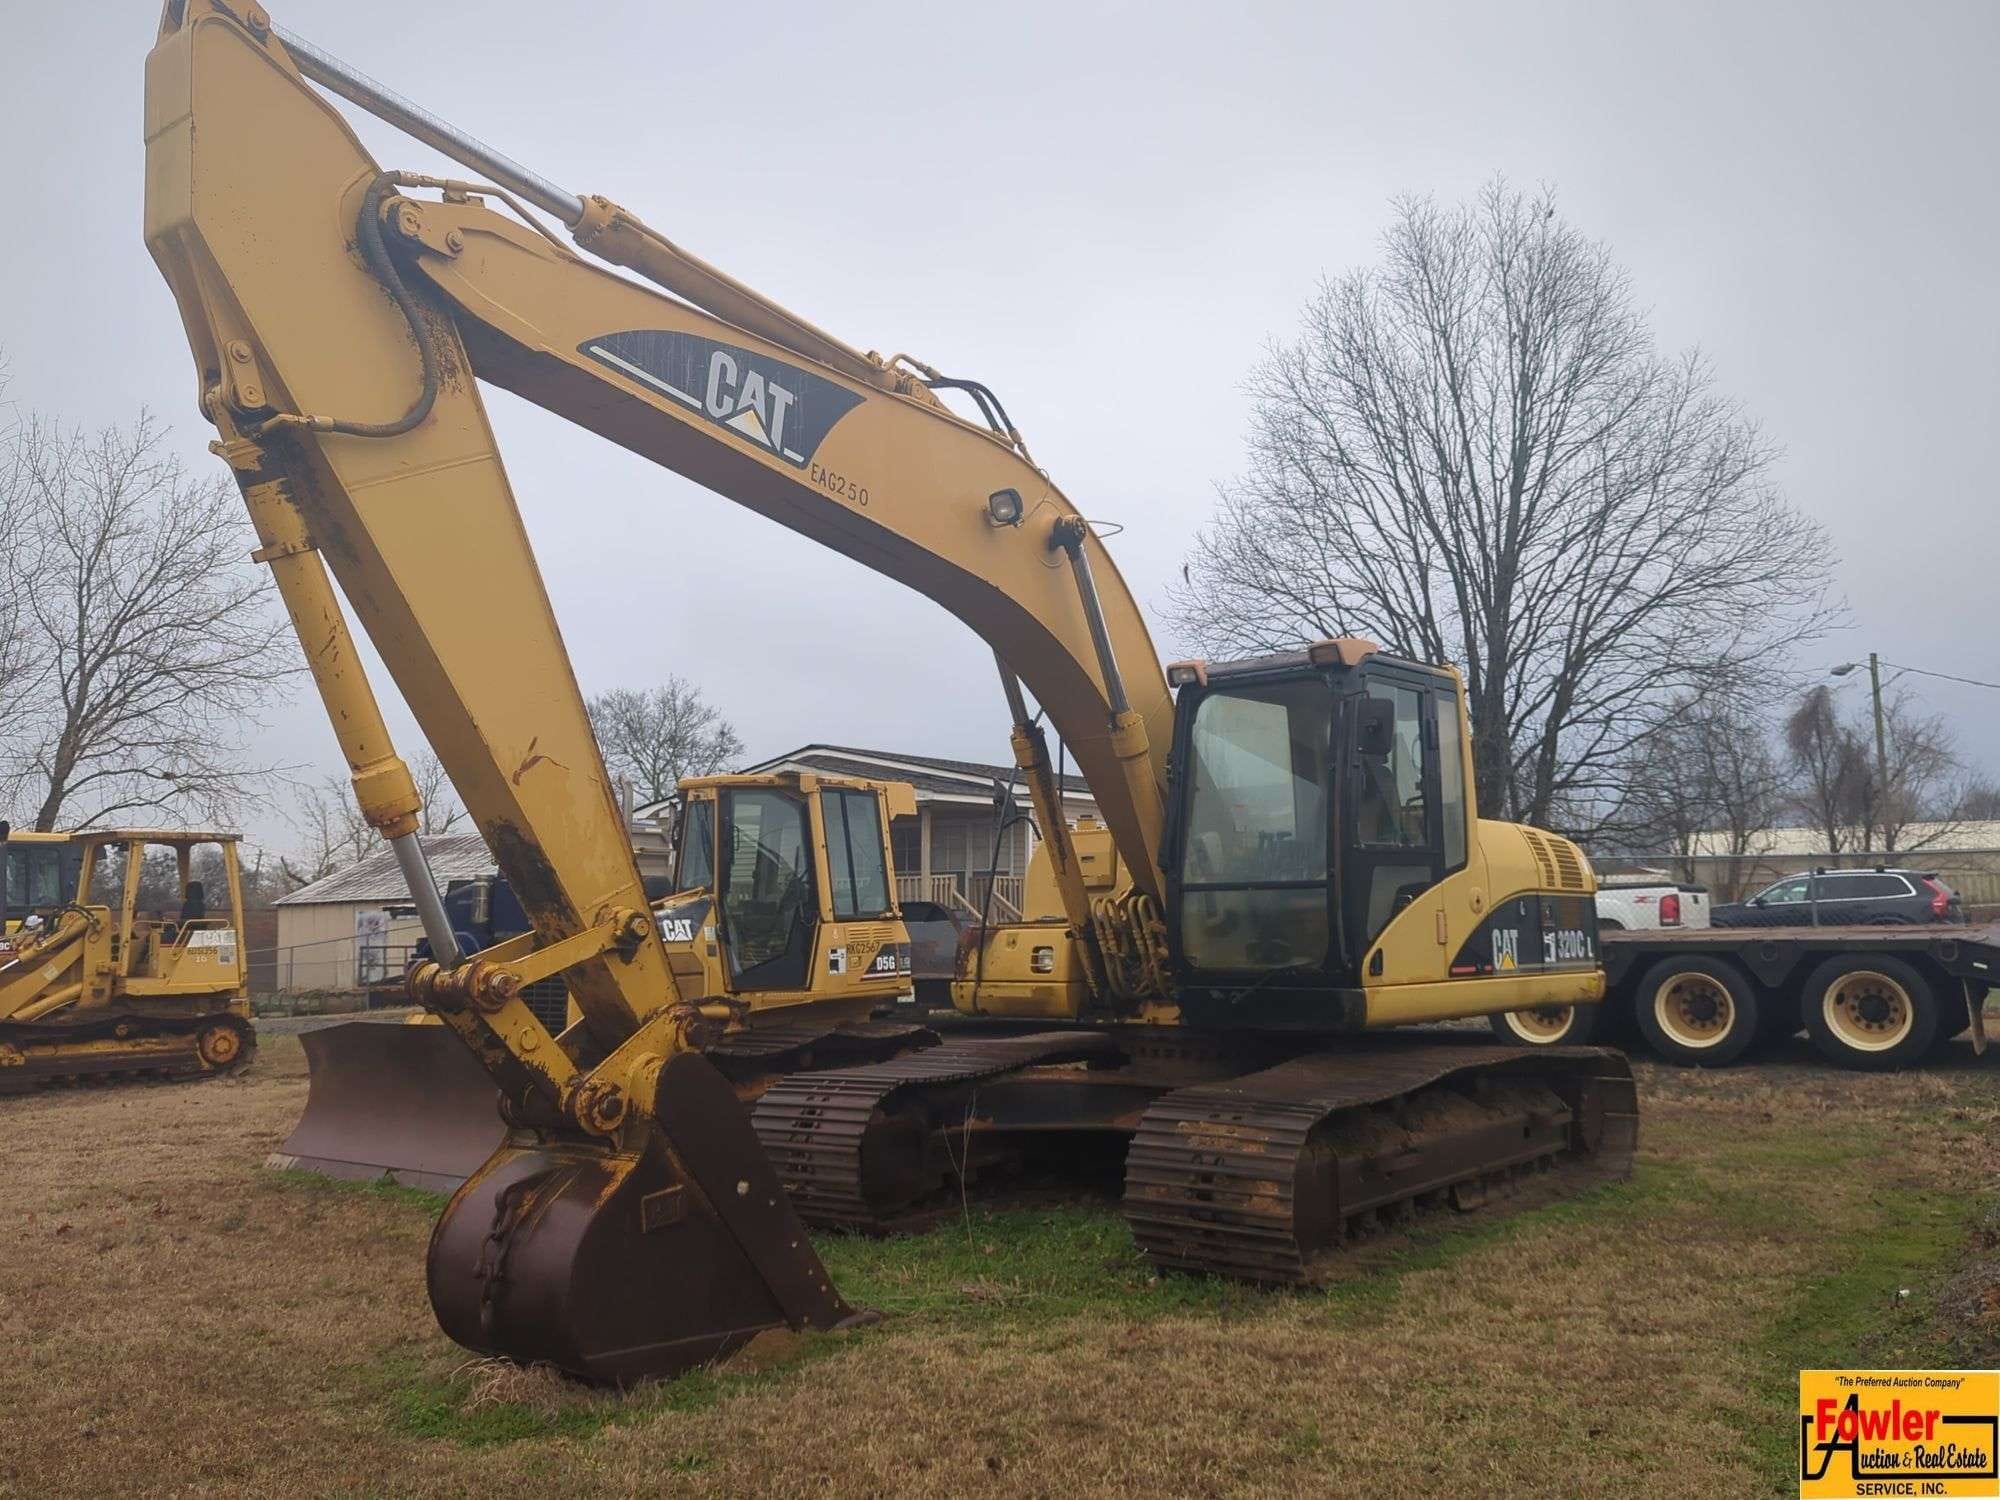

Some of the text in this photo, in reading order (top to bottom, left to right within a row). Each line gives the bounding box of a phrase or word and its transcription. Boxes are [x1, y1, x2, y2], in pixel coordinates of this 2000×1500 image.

[706, 351, 794, 452] CAT
[811, 463, 868, 506] EAG250
[663, 919, 693, 942] CAT
[1558, 929, 1595, 959] 320C L
[876, 955, 896, 971] D5G
[1492, 928, 1519, 970] CAT
